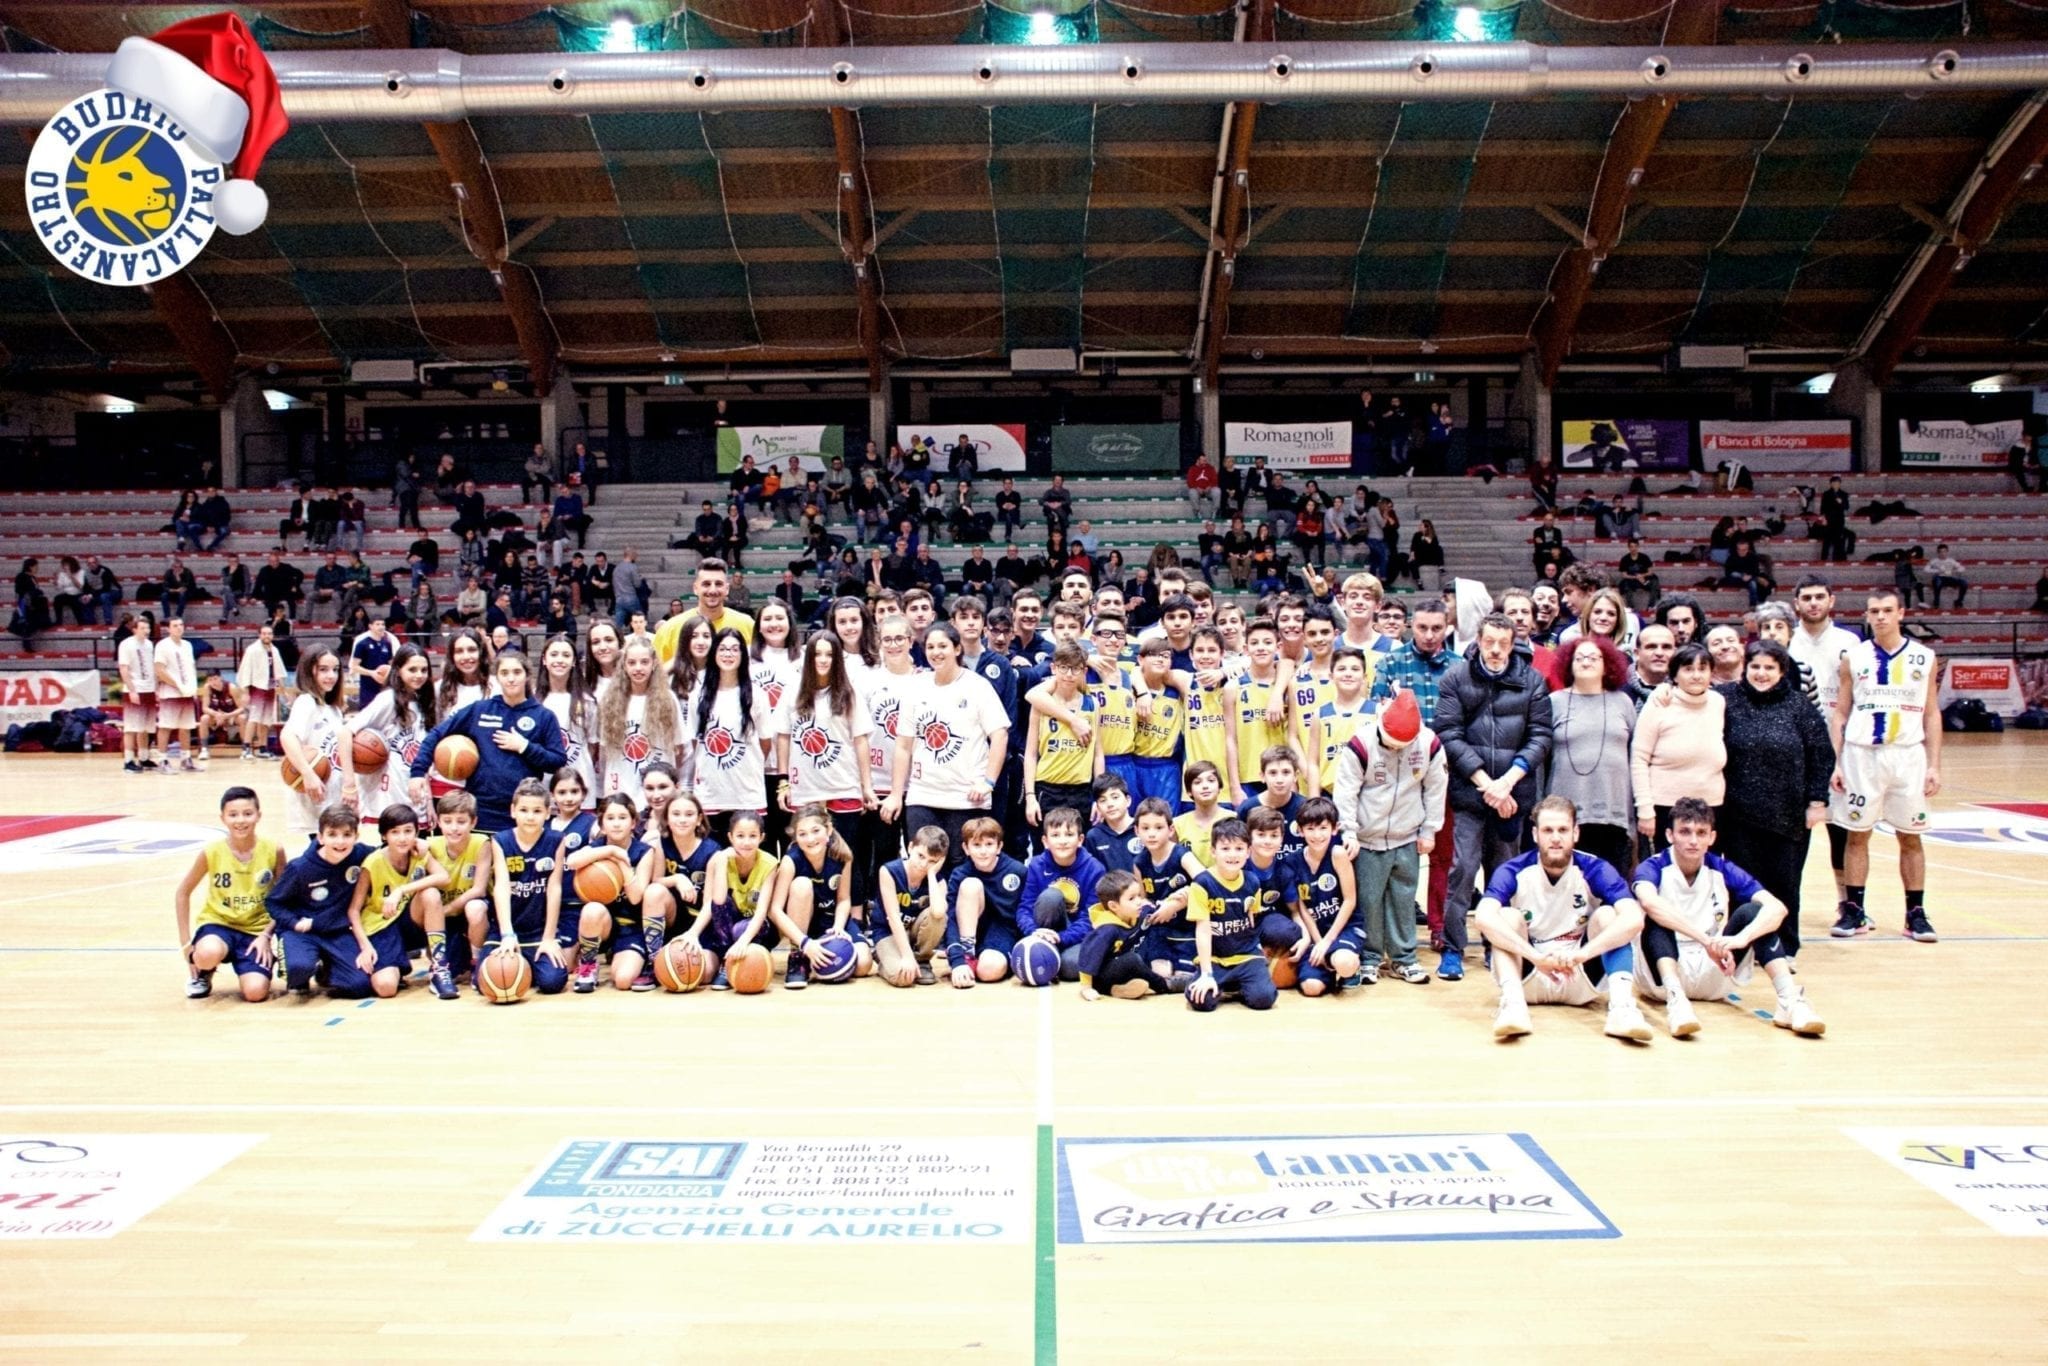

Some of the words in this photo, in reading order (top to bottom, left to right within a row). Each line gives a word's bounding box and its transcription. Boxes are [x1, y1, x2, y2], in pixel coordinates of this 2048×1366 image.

[1243, 427, 1334, 447] Romagnoli
[1719, 436, 1749, 446] Banca
[1752, 436, 1762, 446] di
[1764, 436, 1808, 448] Bologna
[1918, 425, 2005, 444] Romagnoli
[1908, 654, 1926, 665] 20
[1955, 669, 2006, 681] Ser.mac
[0, 678, 67, 706] AD
[1240, 690, 1249, 704] 4
[1297, 688, 1315, 706] 69
[1049, 717, 1059, 733] 6
[1138, 720, 1170, 736] REALE
[1849, 793, 1866, 807] 20
[506, 856, 525, 872] 55
[214, 872, 231, 888] 28
[763, 1144, 789, 1152] Via
[619, 1147, 730, 1177] SAI
[757, 1154, 818, 1162] 40054
[825, 1154, 899, 1162] BUDRIO
[907, 1154, 950, 1163] (BO)
[744, 1176, 778, 1185] Fax
[1278, 1180, 1369, 1188] BOLOGNA
[582, 1184, 714, 1197] FONDIARIA
[569, 1201, 744, 1218] Agenzia
[761, 1202, 954, 1216] Generale
[1093, 1202, 1290, 1229] Grafica
[1309, 1200, 1341, 1214] e
[1352, 1190, 1554, 1214] Stampa
[502, 1220, 547, 1235] di
[557, 1222, 794, 1236] ZUCCHELLI
[807, 1223, 1003, 1237] AURELIO
